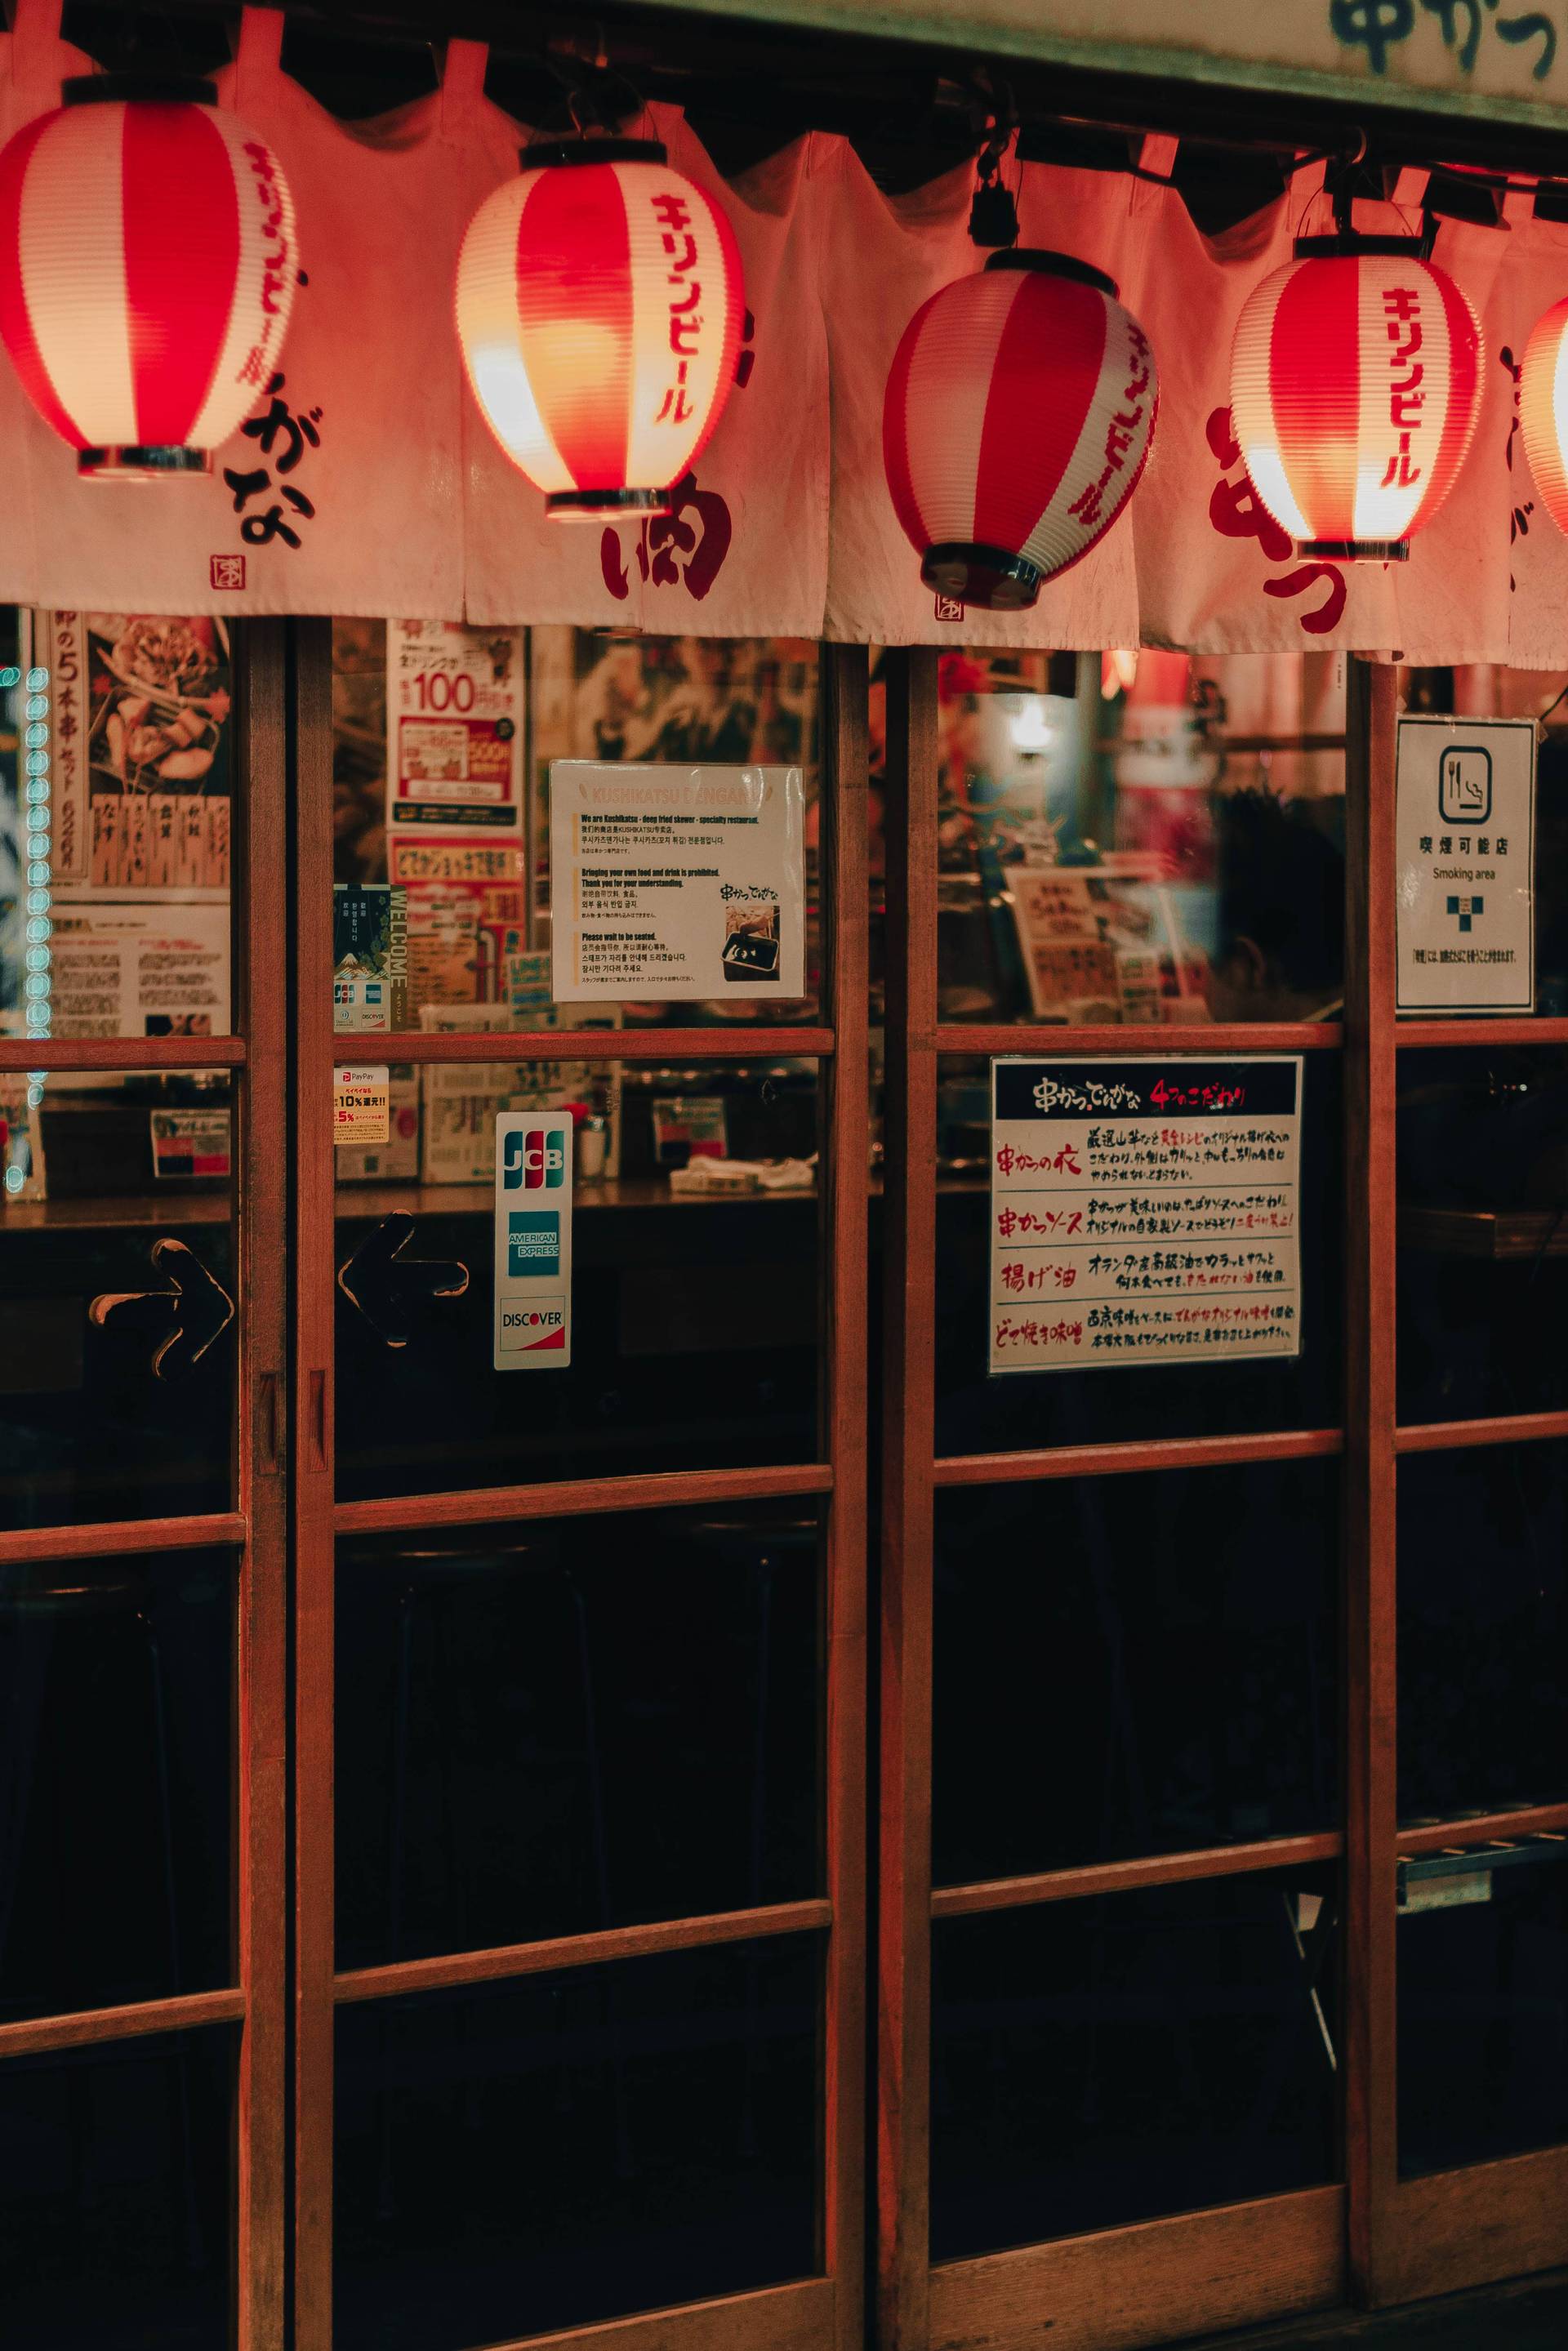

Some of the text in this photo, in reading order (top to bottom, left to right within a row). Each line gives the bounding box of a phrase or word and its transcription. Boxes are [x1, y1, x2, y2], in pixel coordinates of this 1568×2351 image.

[651, 194, 704, 424] キリンビール
[1380, 288, 1426, 488] キリンビール
[581, 815, 591, 823] We
[674, 816, 695, 824] skewer
[1420, 836, 1508, 855] 喫煙可能店
[581, 869, 608, 878] Bringing
[609, 870, 623, 878] your
[638, 869, 651, 877] food
[653, 869, 663, 877] and
[665, 869, 680, 877] drink
[681, 869, 688, 877] is
[1433, 867, 1496, 882] Smoking area
[582, 879, 600, 888] Thank
[614, 879, 622, 888] for
[624, 880, 637, 888] your
[638, 879, 684, 888] understanding.
[390, 888, 408, 988] WELCOME
[338, 1111, 354, 1123] 5%
[996, 1143, 1082, 1178] 串かつの衣
[998, 1207, 1083, 1239] 串かつソース
[510, 1233, 556, 1243] AMERICAN
[519, 1246, 559, 1256] EXPRESS
[1001, 1261, 1077, 1293] 揚げ油
[503, 1311, 562, 1327] DISCOVER
[996, 1318, 1083, 1348] どて焼き味噌
